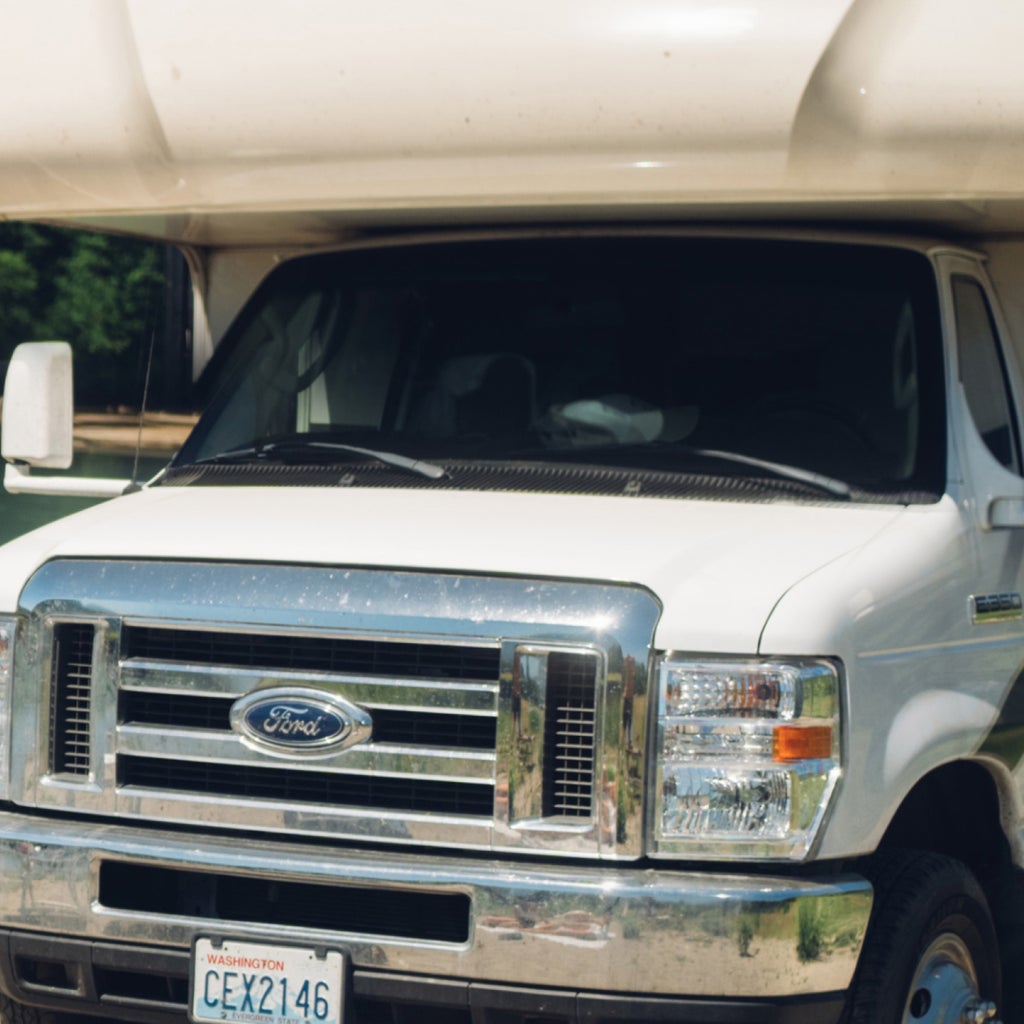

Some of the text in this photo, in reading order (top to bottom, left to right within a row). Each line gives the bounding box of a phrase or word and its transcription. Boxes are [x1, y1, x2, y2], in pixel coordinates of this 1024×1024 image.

[263, 705, 321, 737] Ford
[207, 953, 285, 972] WASHINGTON
[203, 969, 330, 1021] CEX2146
[231, 1012, 275, 1024] EVERGREEN
